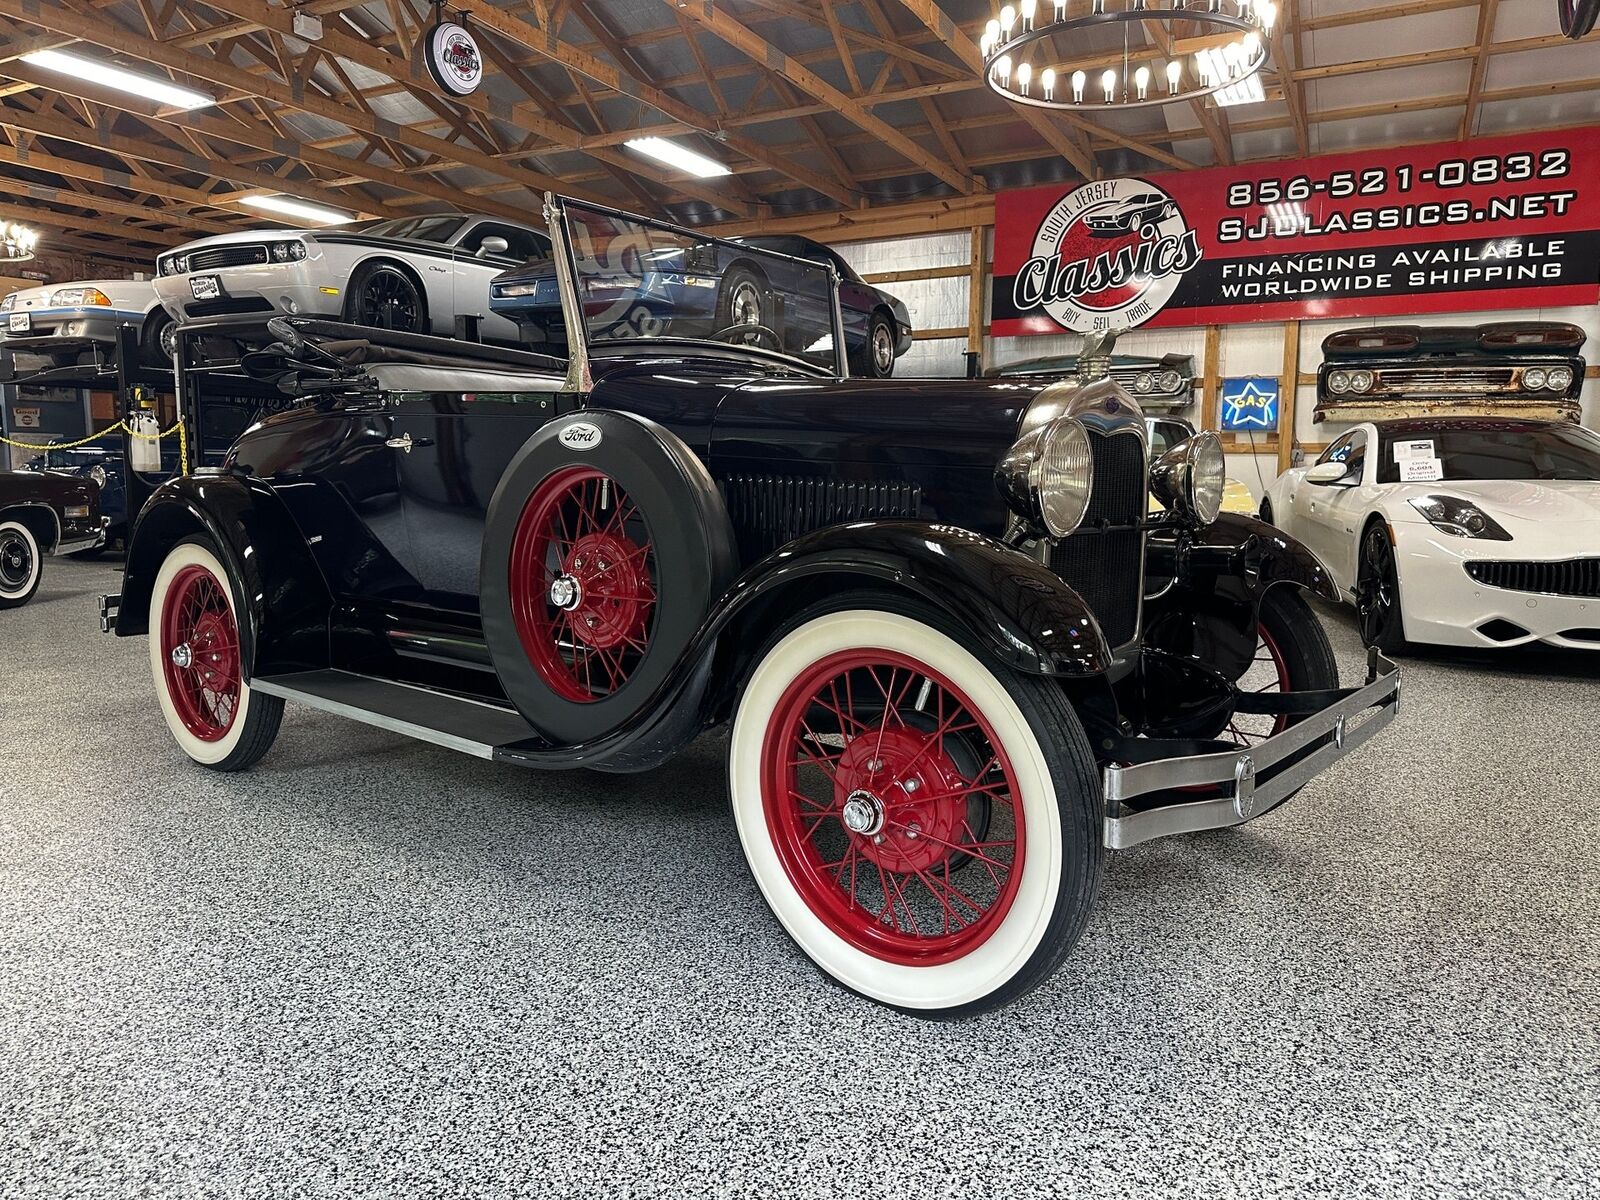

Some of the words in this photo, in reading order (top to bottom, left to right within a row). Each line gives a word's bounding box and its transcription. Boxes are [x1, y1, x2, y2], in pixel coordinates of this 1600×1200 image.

[444, 48, 480, 71] Classics
[1228, 151, 1568, 206] 856-521-0832
[1041, 204, 1073, 243] SOUTH
[1075, 181, 1118, 210] JERSEY
[1218, 192, 1575, 241] SJCLASSICS.NET
[1013, 223, 1203, 310] Classics
[1222, 254, 1376, 279] FINANCING
[1392, 240, 1565, 266] AVAILABLE
[1221, 273, 1392, 298] WORLDWIDE
[1408, 263, 1562, 287] SHIPPING
[1061, 307, 1081, 325] BUY
[1093, 316, 1110, 330] SELL
[1124, 300, 1153, 323] TRADE
[1234, 394, 1267, 408] GAS
[564, 426, 595, 442] Ford
